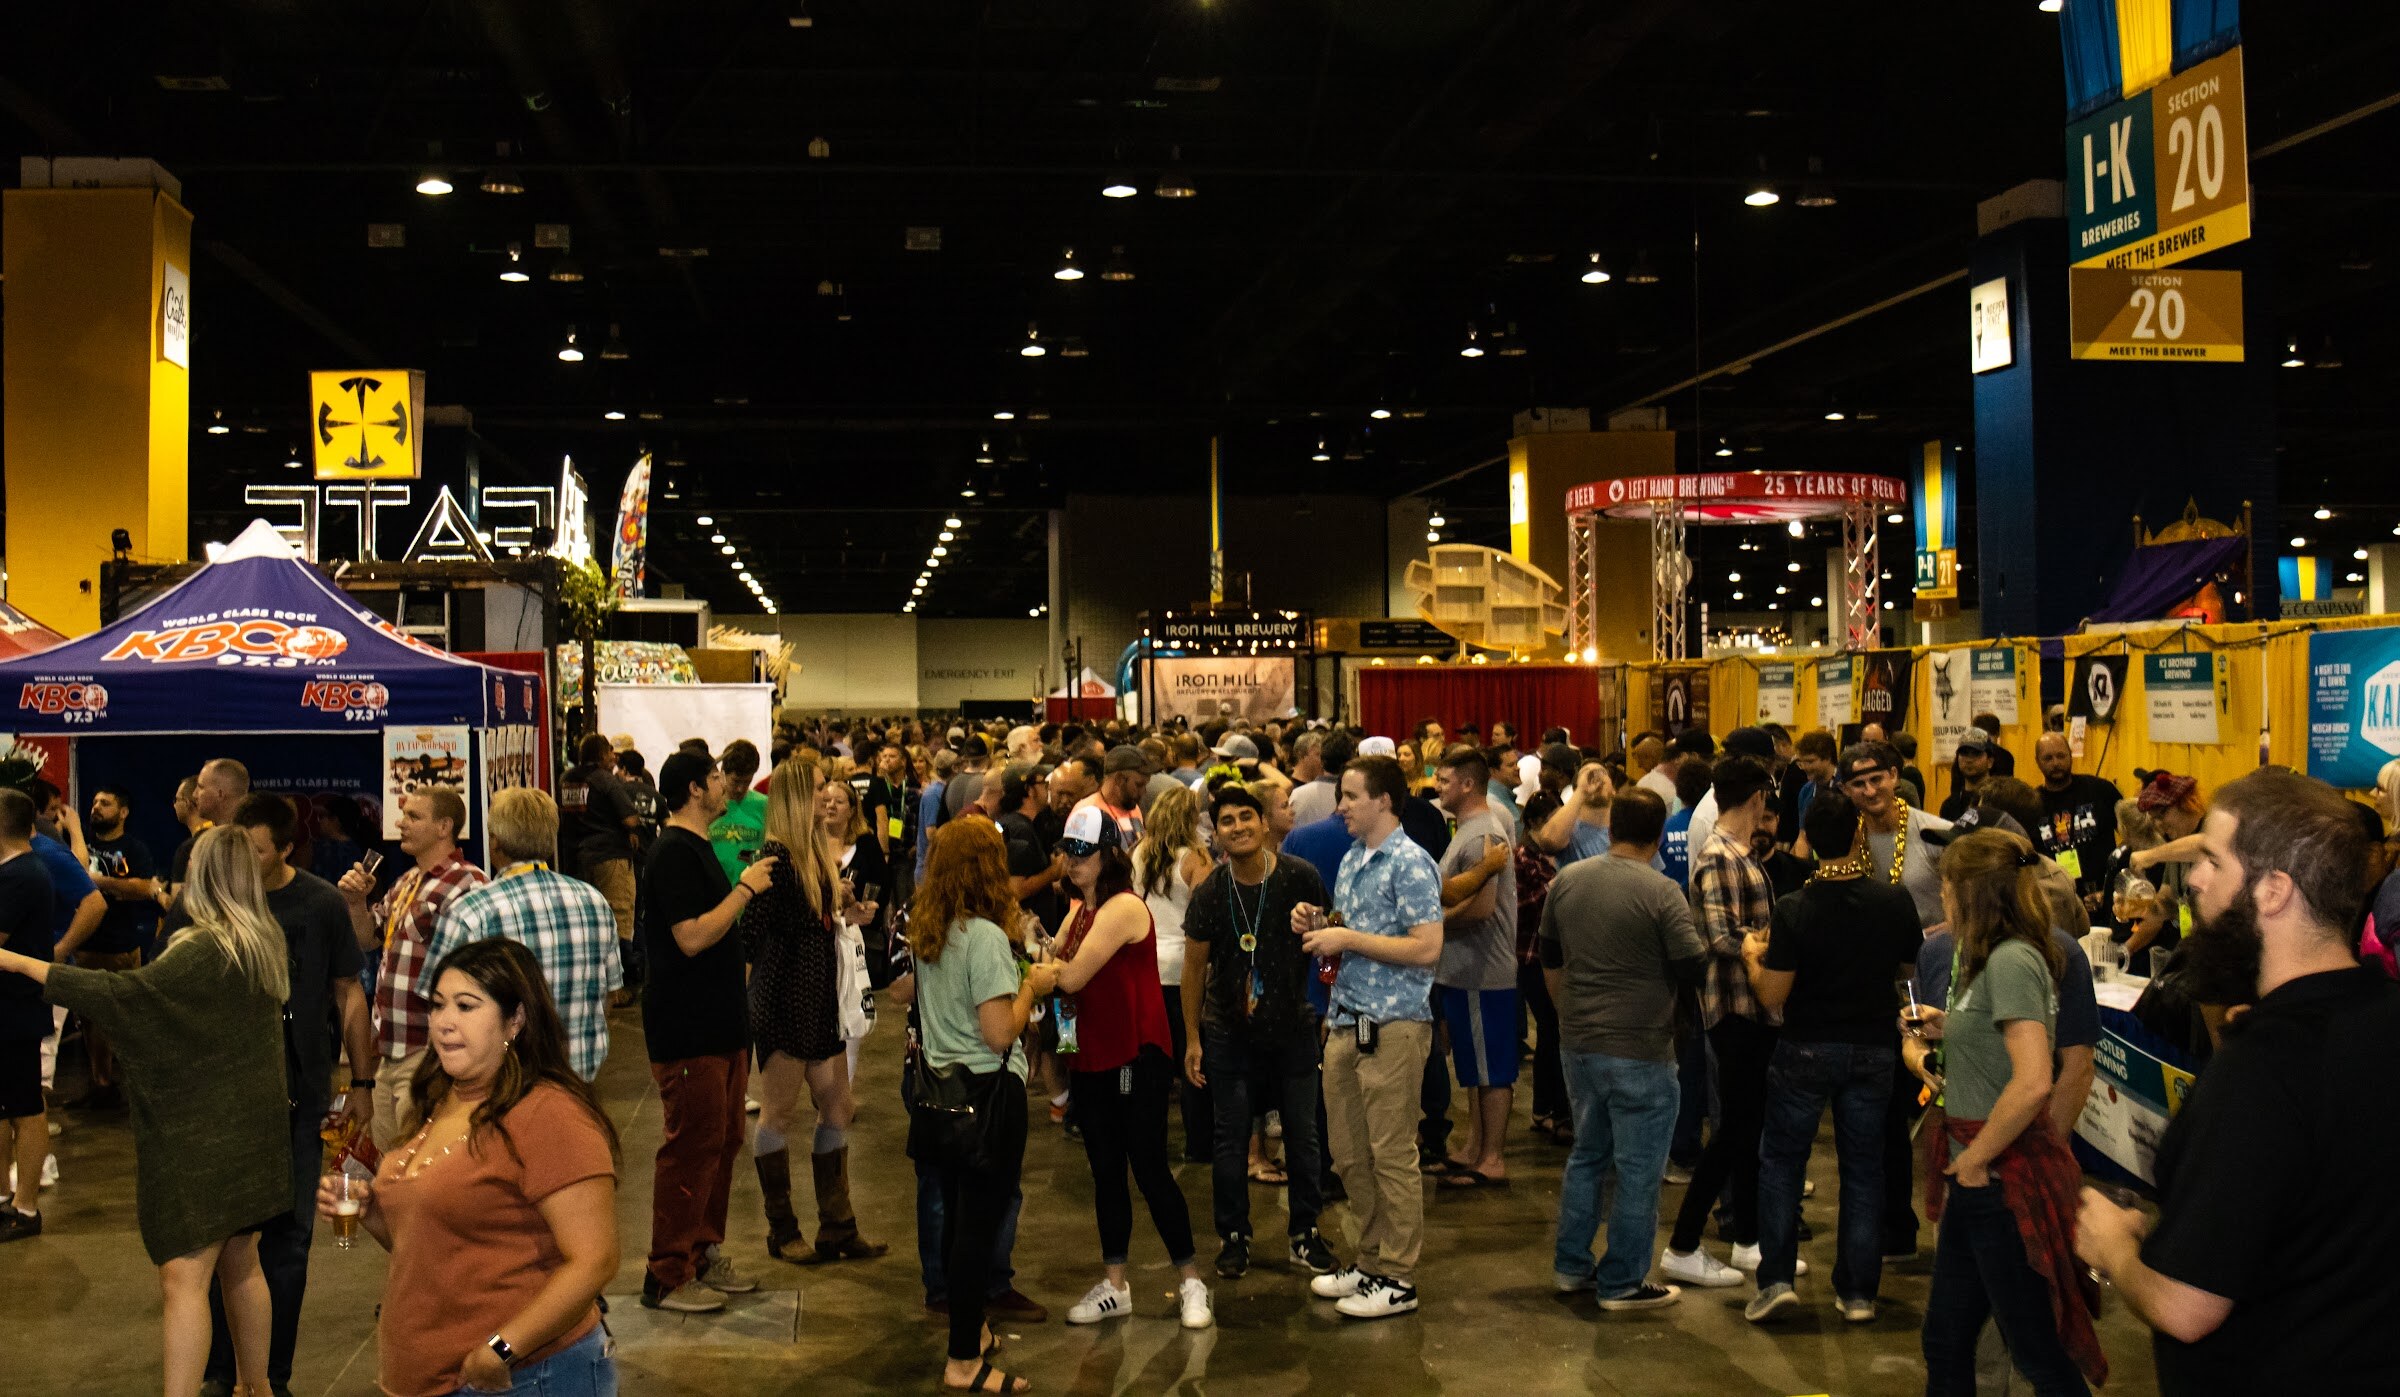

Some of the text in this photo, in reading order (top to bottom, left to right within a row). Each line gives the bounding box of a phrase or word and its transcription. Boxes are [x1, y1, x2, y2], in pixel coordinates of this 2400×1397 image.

[2168, 75, 2220, 114] SECTION
[2083, 115, 2136, 215] I-K
[2168, 104, 2225, 212] 20
[2081, 211, 2141, 248] BREWERIES
[2106, 225, 2206, 270] MEET THE BREWER
[2131, 275, 2183, 287] SECTION
[2130, 288, 2185, 340] 20
[2109, 347, 2207, 357] MEET THE BREWER
[1574, 486, 1595, 507] BEER
[1628, 479, 1647, 500] LEFT
[1650, 478, 1674, 498] HAND
[1679, 476, 1725, 497] BREWING
[1765, 476, 1894, 499] 25 YEARS OF BEER
[1918, 554, 1934, 579] P-R
[1940, 560, 1951, 586] 21
[162, 608, 318, 629] WORLD CLASS ROCK
[1165, 623, 1297, 637] IRON HILL BREWERY
[100, 619, 349, 663] KBCO
[217, 653, 337, 668] 97.3 FM
[2168, 656, 2197, 668] BROTHERS
[924, 668, 1015, 680] EMERGENCY EXIT
[1176, 673, 1262, 687] IRON HILL
[2164, 669, 2191, 680] BREWING
[19, 682, 109, 714] KBCO
[301, 681, 389, 712] KBCO
[1861, 688, 1893, 713] JAGGED
[63, 710, 108, 724] 97.3 FM
[345, 708, 389, 722] 97.3 FM
[253, 778, 361, 788] WORLD CLASS ROCK
